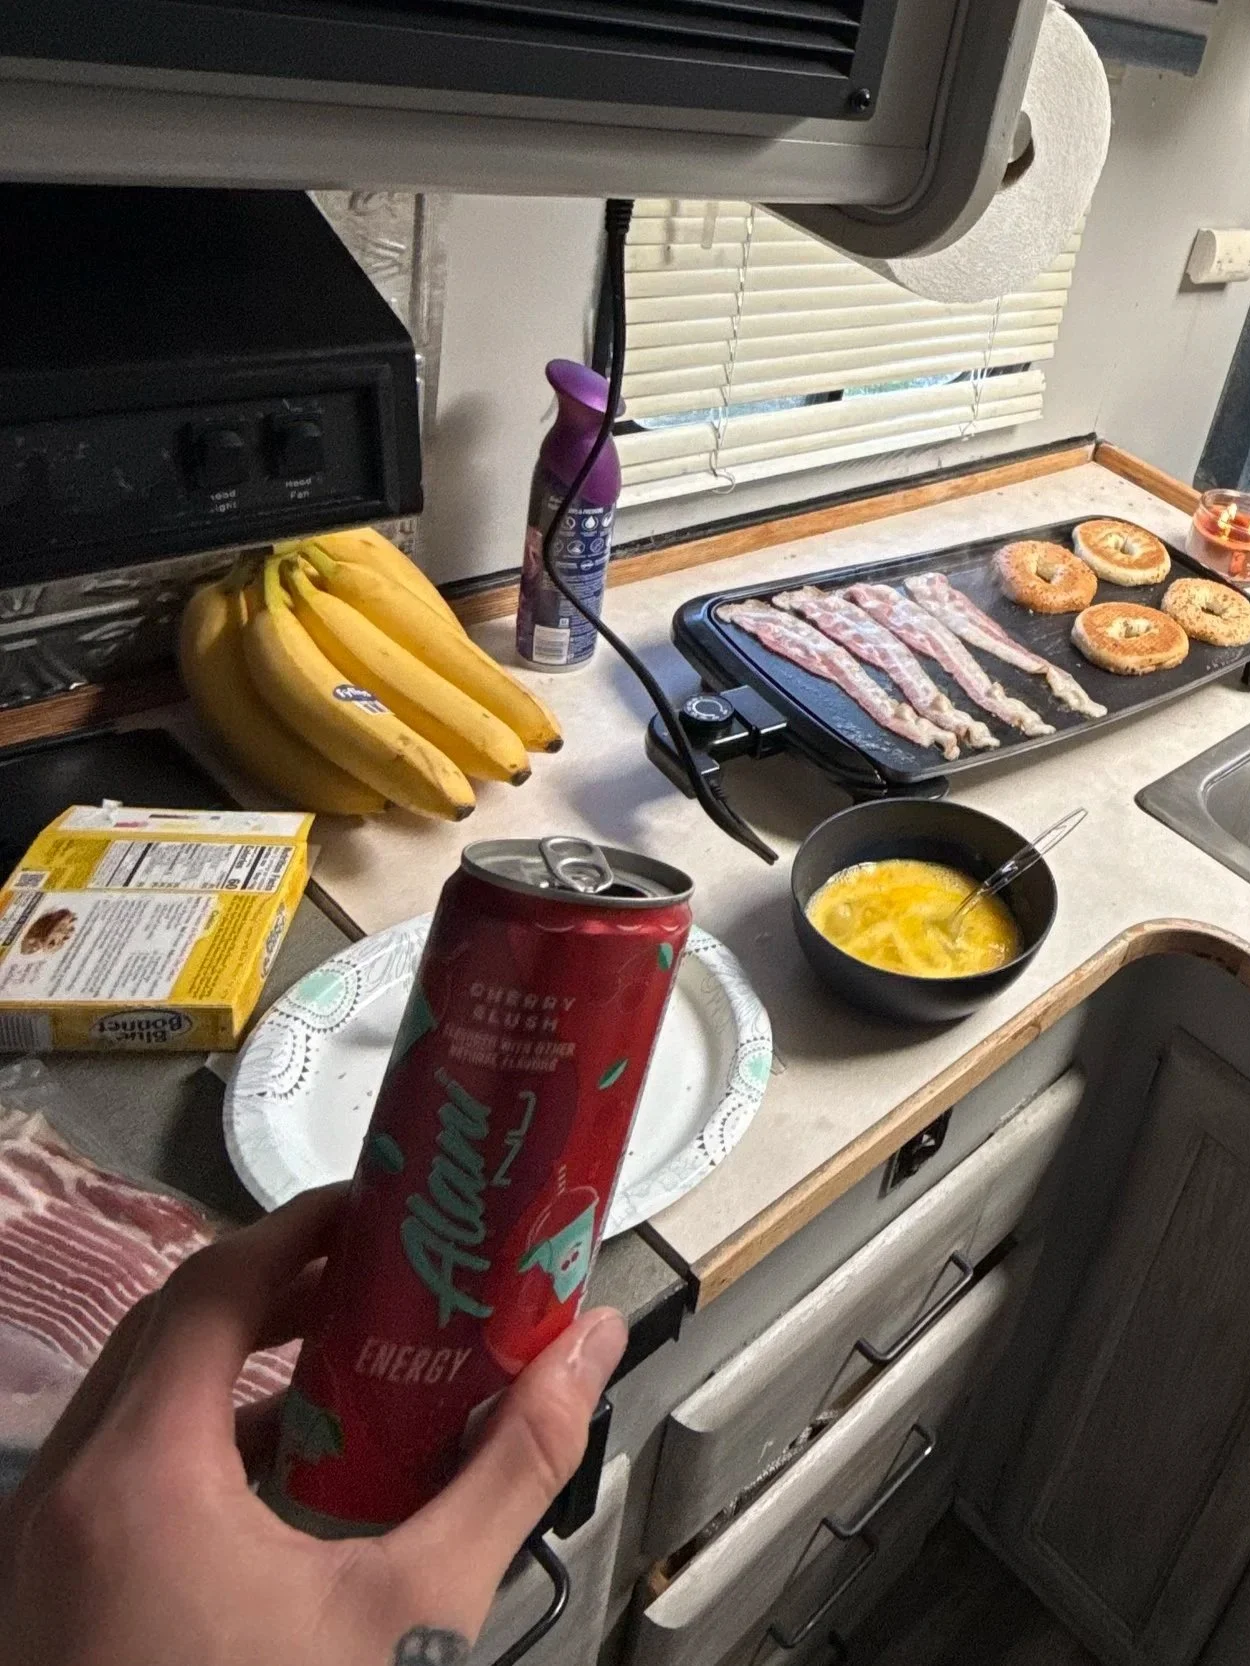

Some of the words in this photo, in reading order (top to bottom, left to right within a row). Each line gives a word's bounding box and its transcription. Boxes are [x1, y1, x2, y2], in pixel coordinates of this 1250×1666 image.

[290, 490, 310, 500] Fan
[225, 878, 240, 890] 60
[470, 982, 576, 1012] CHERRY
[99, 1014, 183, 1033] Bonnet
[474, 1004, 558, 1033] SLUSH
[115, 1030, 168, 1043] Blue
[400, 1066, 493, 1328] Alani
[355, 1336, 474, 1384] ENERGY
